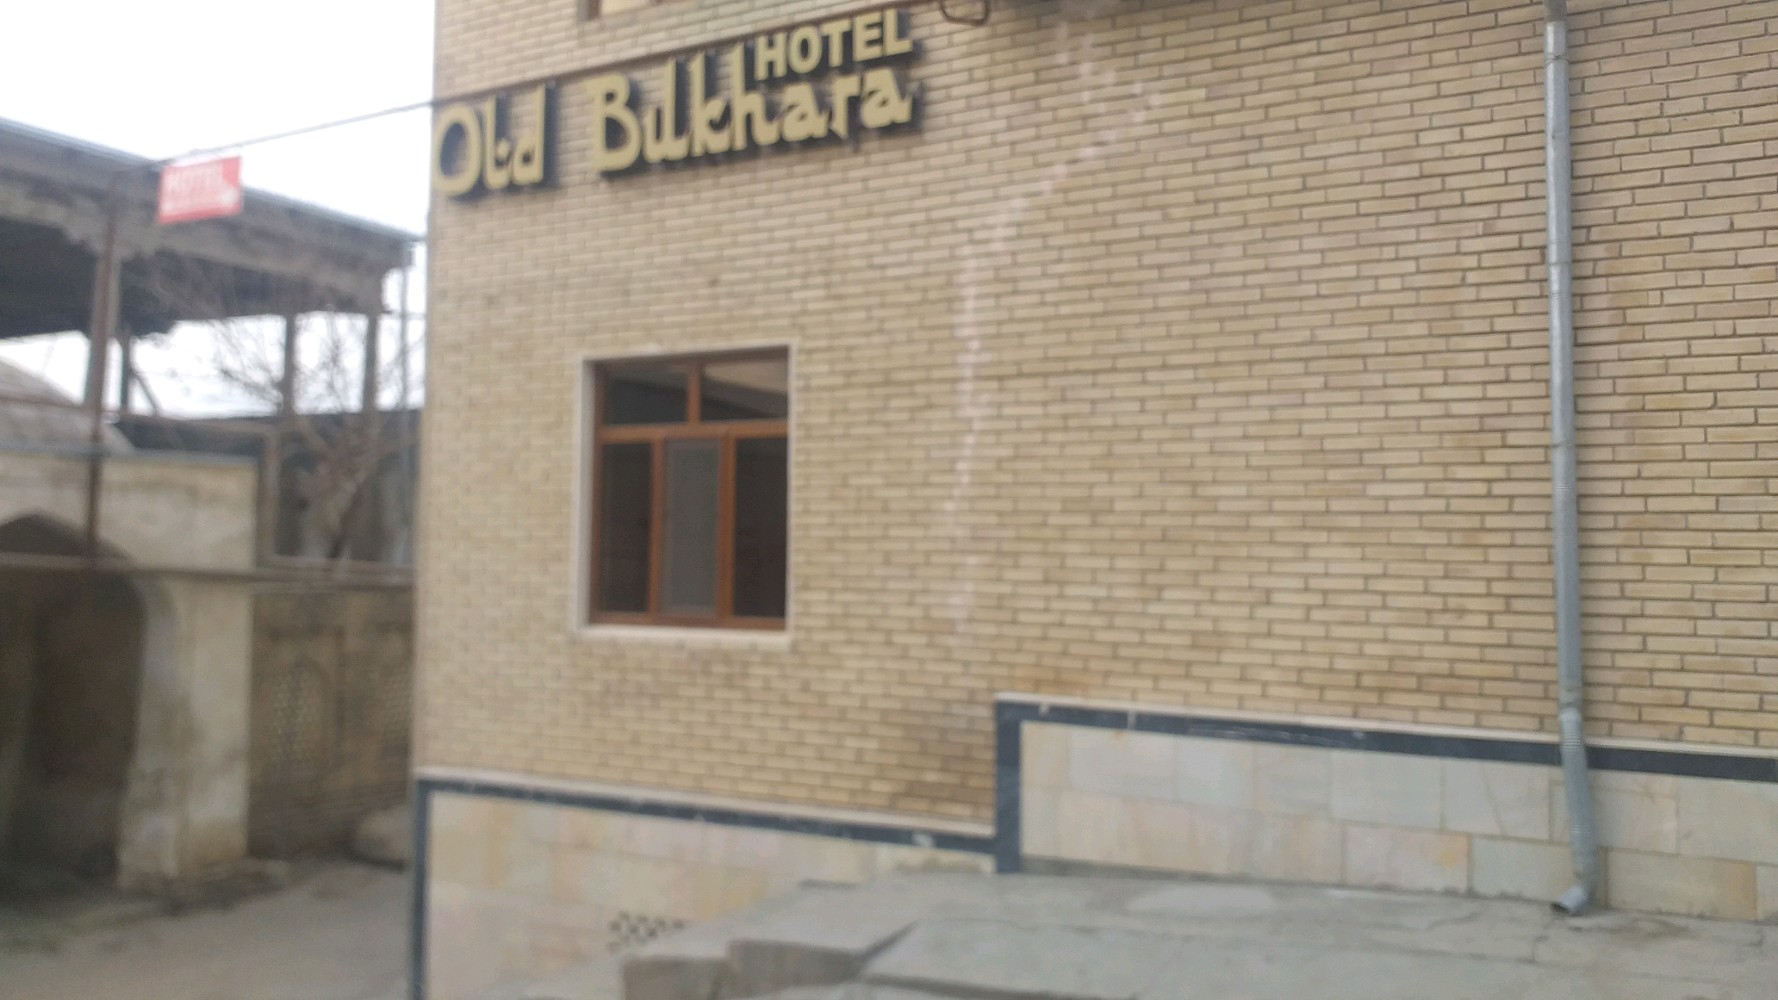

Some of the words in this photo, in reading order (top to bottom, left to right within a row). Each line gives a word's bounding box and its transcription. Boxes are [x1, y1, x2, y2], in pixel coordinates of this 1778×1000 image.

[755, 9, 913, 82] HOTEL
[434, 84, 545, 197] Old
[586, 42, 913, 172] Bukhara
